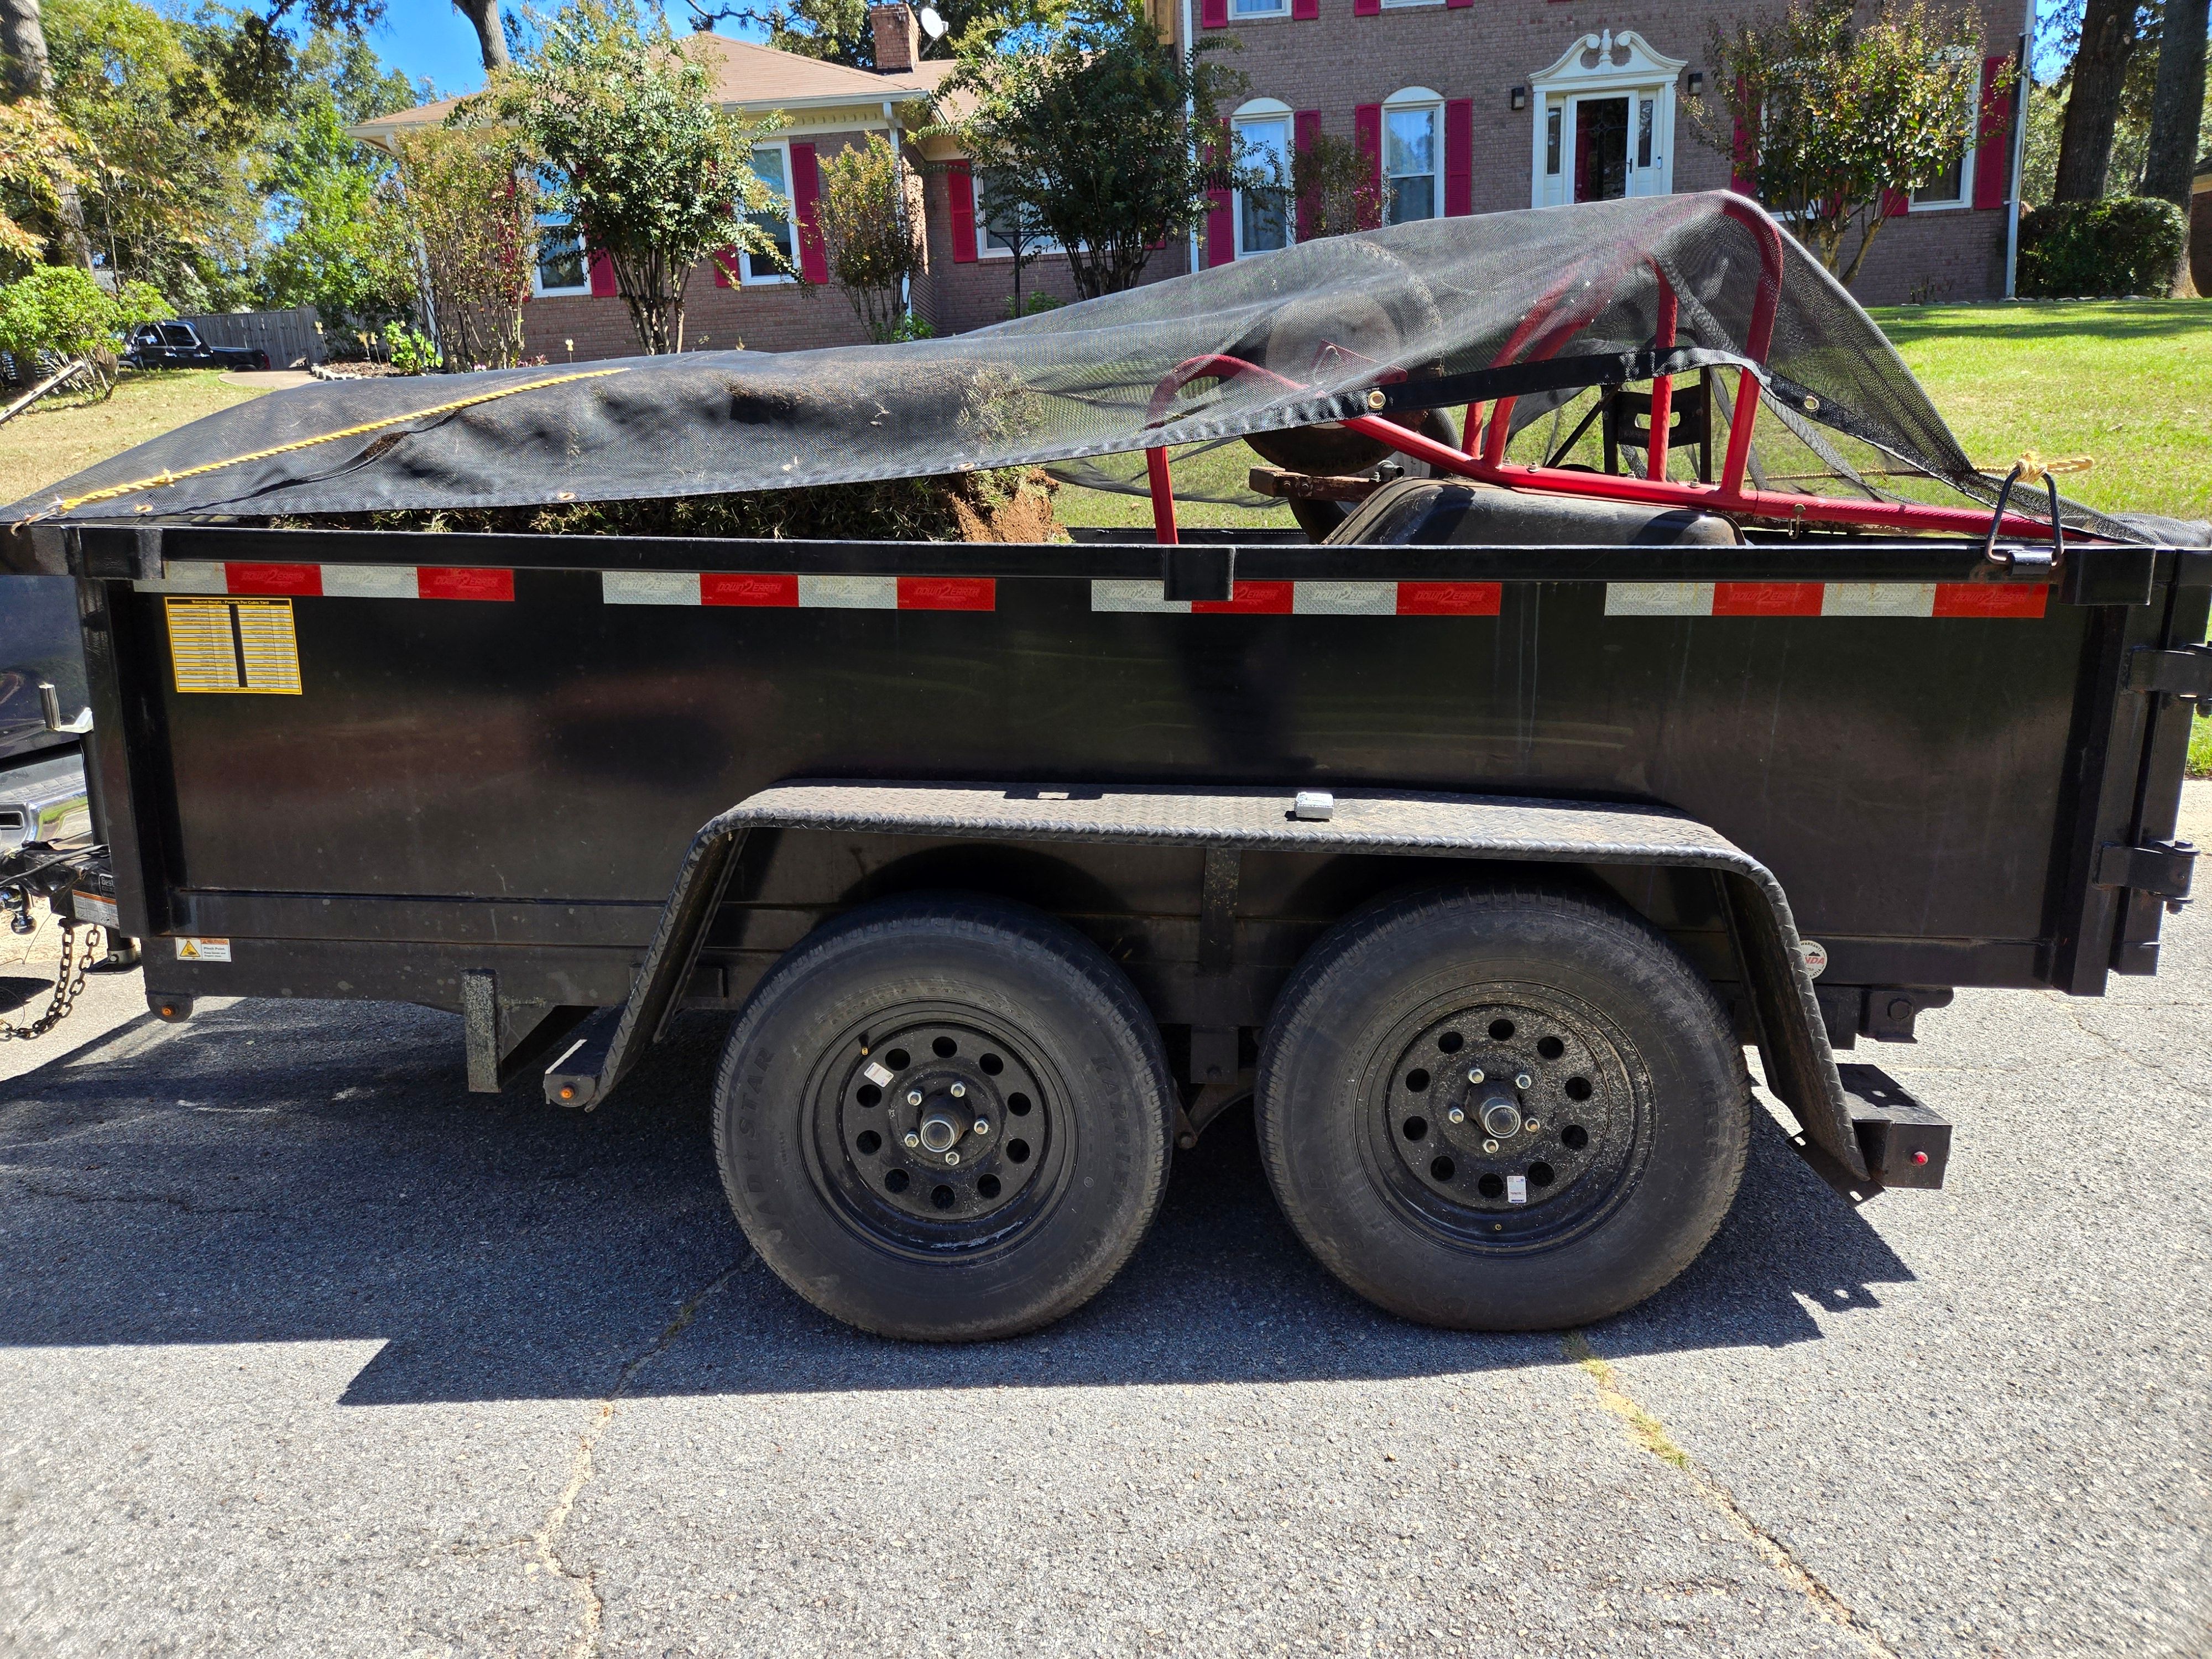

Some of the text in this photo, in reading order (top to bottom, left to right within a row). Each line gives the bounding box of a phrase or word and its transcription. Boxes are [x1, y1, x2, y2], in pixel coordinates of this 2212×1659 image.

[1801, 942, 1822, 952] WARRANTY
[738, 1047, 775, 1138] STAR
[1090, 1054, 1131, 1210] KARRIER
